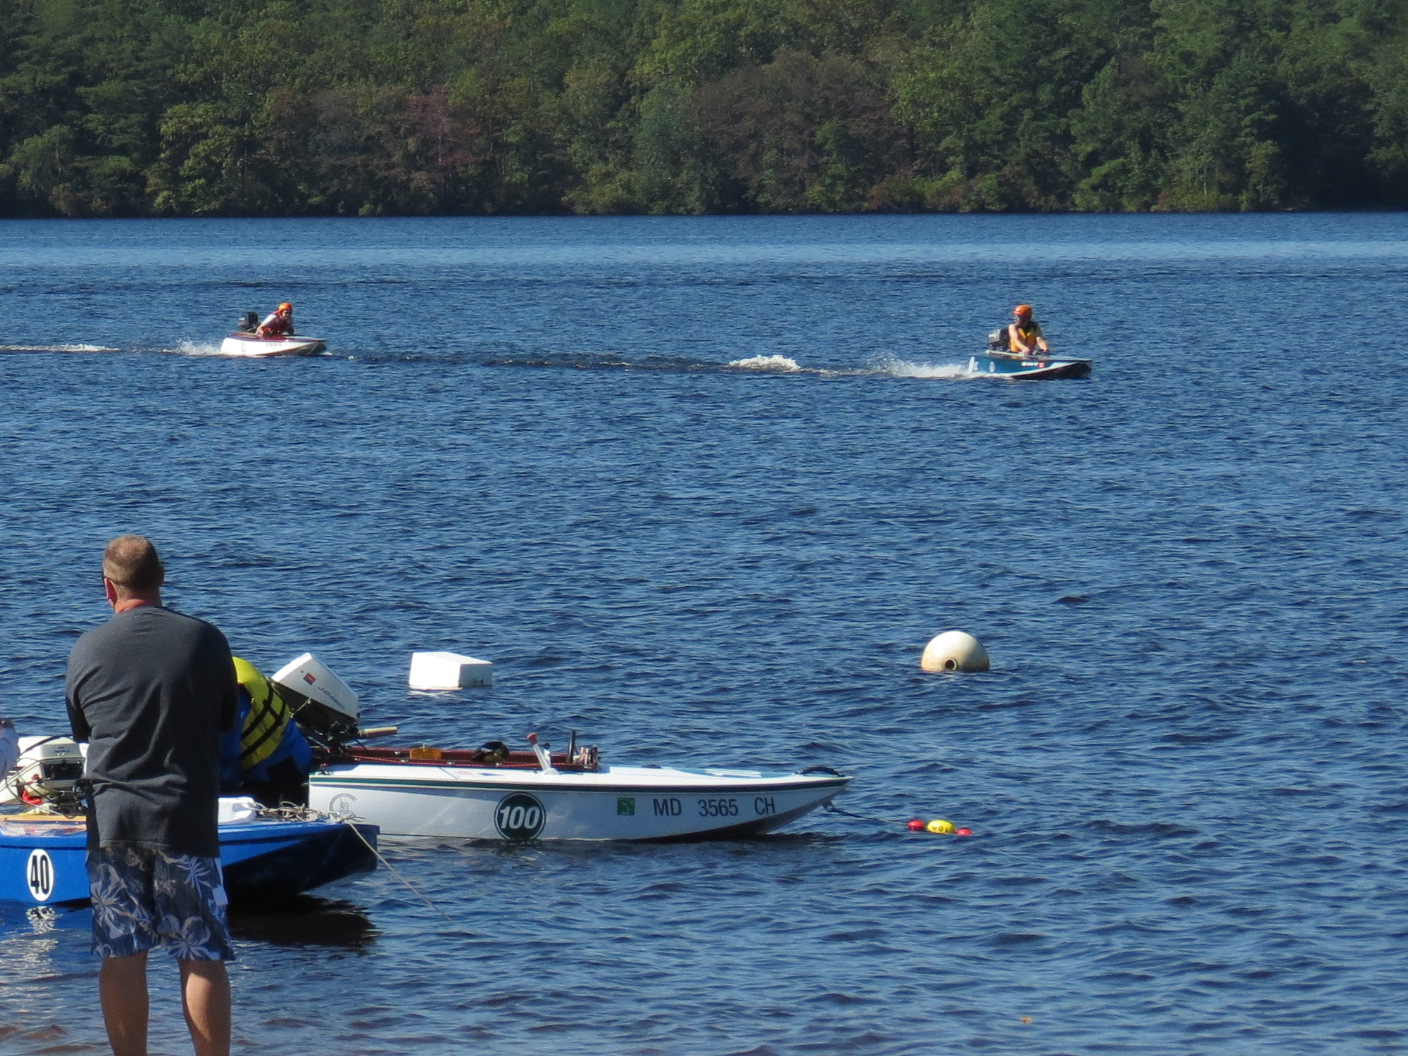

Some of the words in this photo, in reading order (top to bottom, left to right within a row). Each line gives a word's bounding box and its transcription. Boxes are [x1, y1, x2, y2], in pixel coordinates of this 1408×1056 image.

[498, 805, 540, 830] 100
[652, 798, 682, 817] MD
[697, 798, 739, 817] 3565
[753, 796, 776, 816] CH
[30, 854, 51, 895] 40
